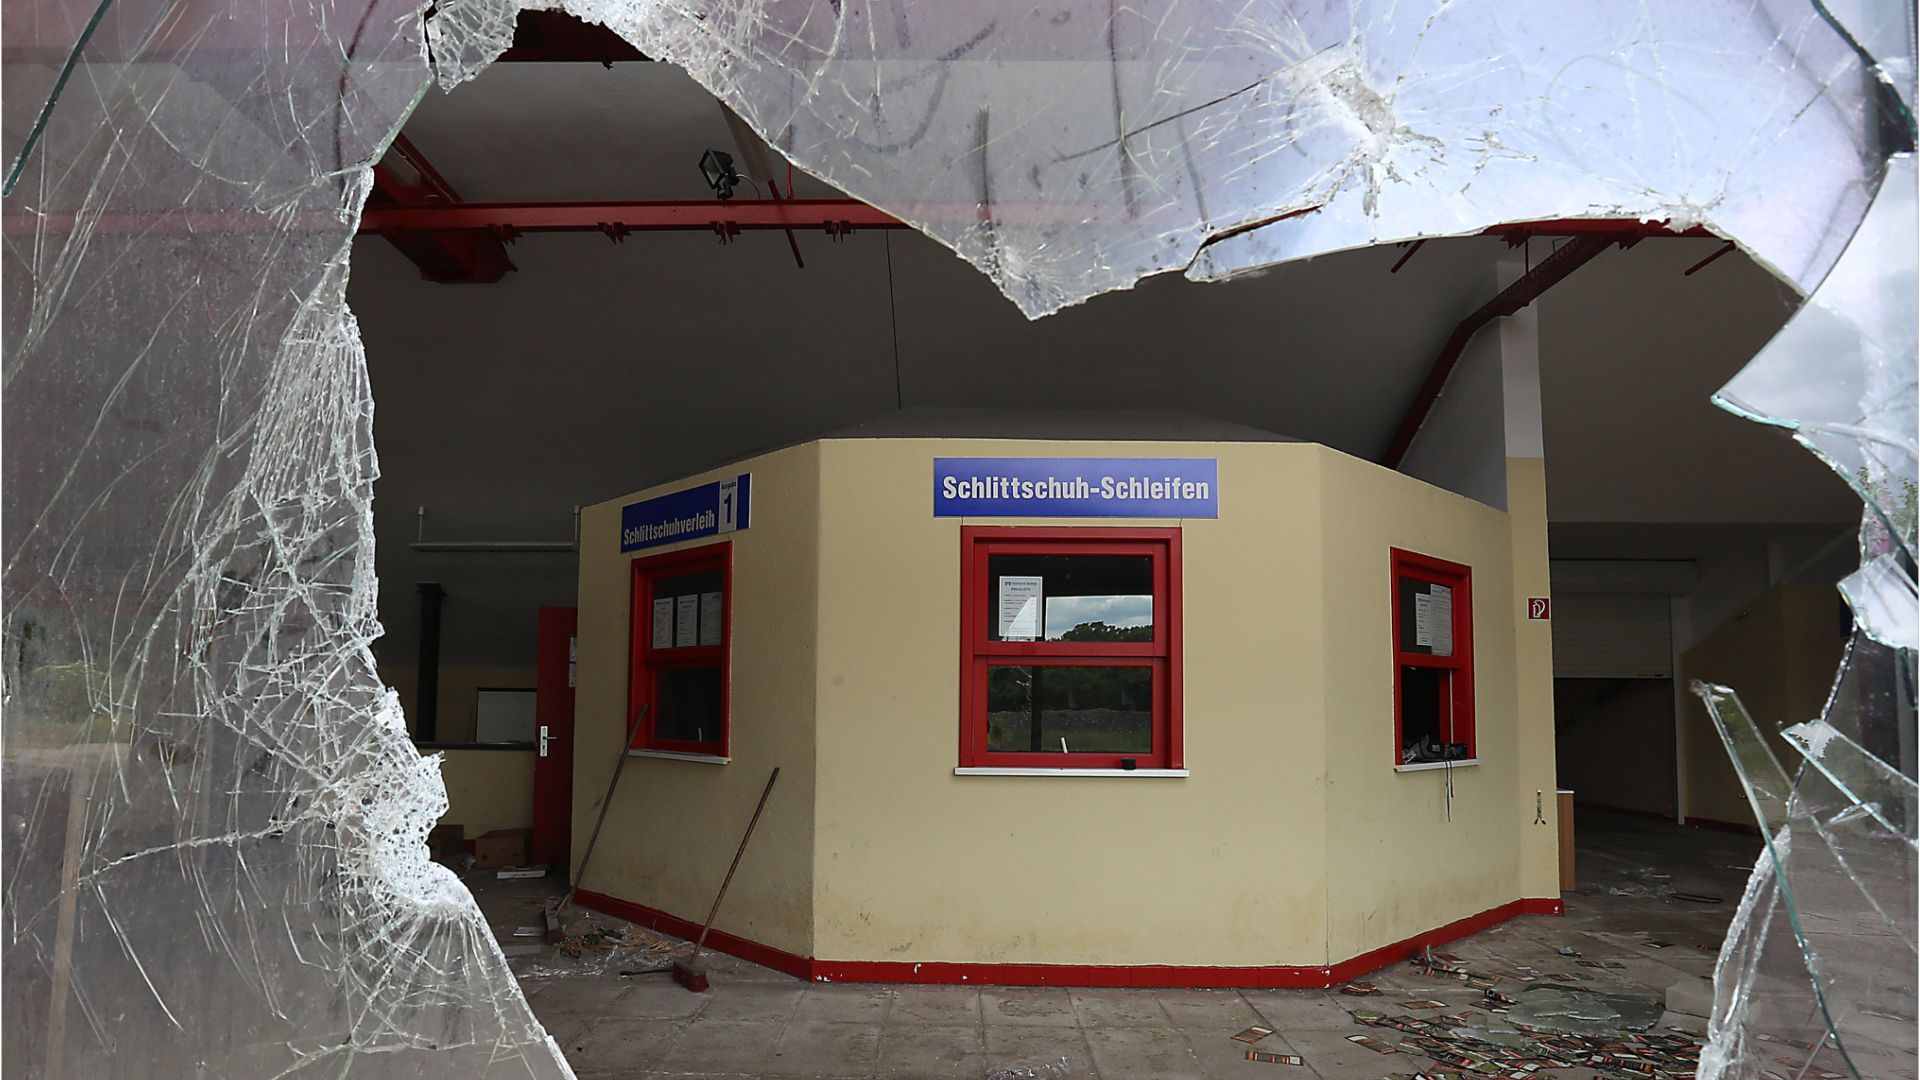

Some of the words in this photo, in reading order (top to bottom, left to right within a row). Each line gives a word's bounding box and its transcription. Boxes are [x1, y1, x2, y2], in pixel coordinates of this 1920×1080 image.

[943, 475, 1209, 500] Schlittschuh-Schleifen
[723, 492, 732, 524] 1
[623, 509, 715, 546] Schlittschuhverleih
